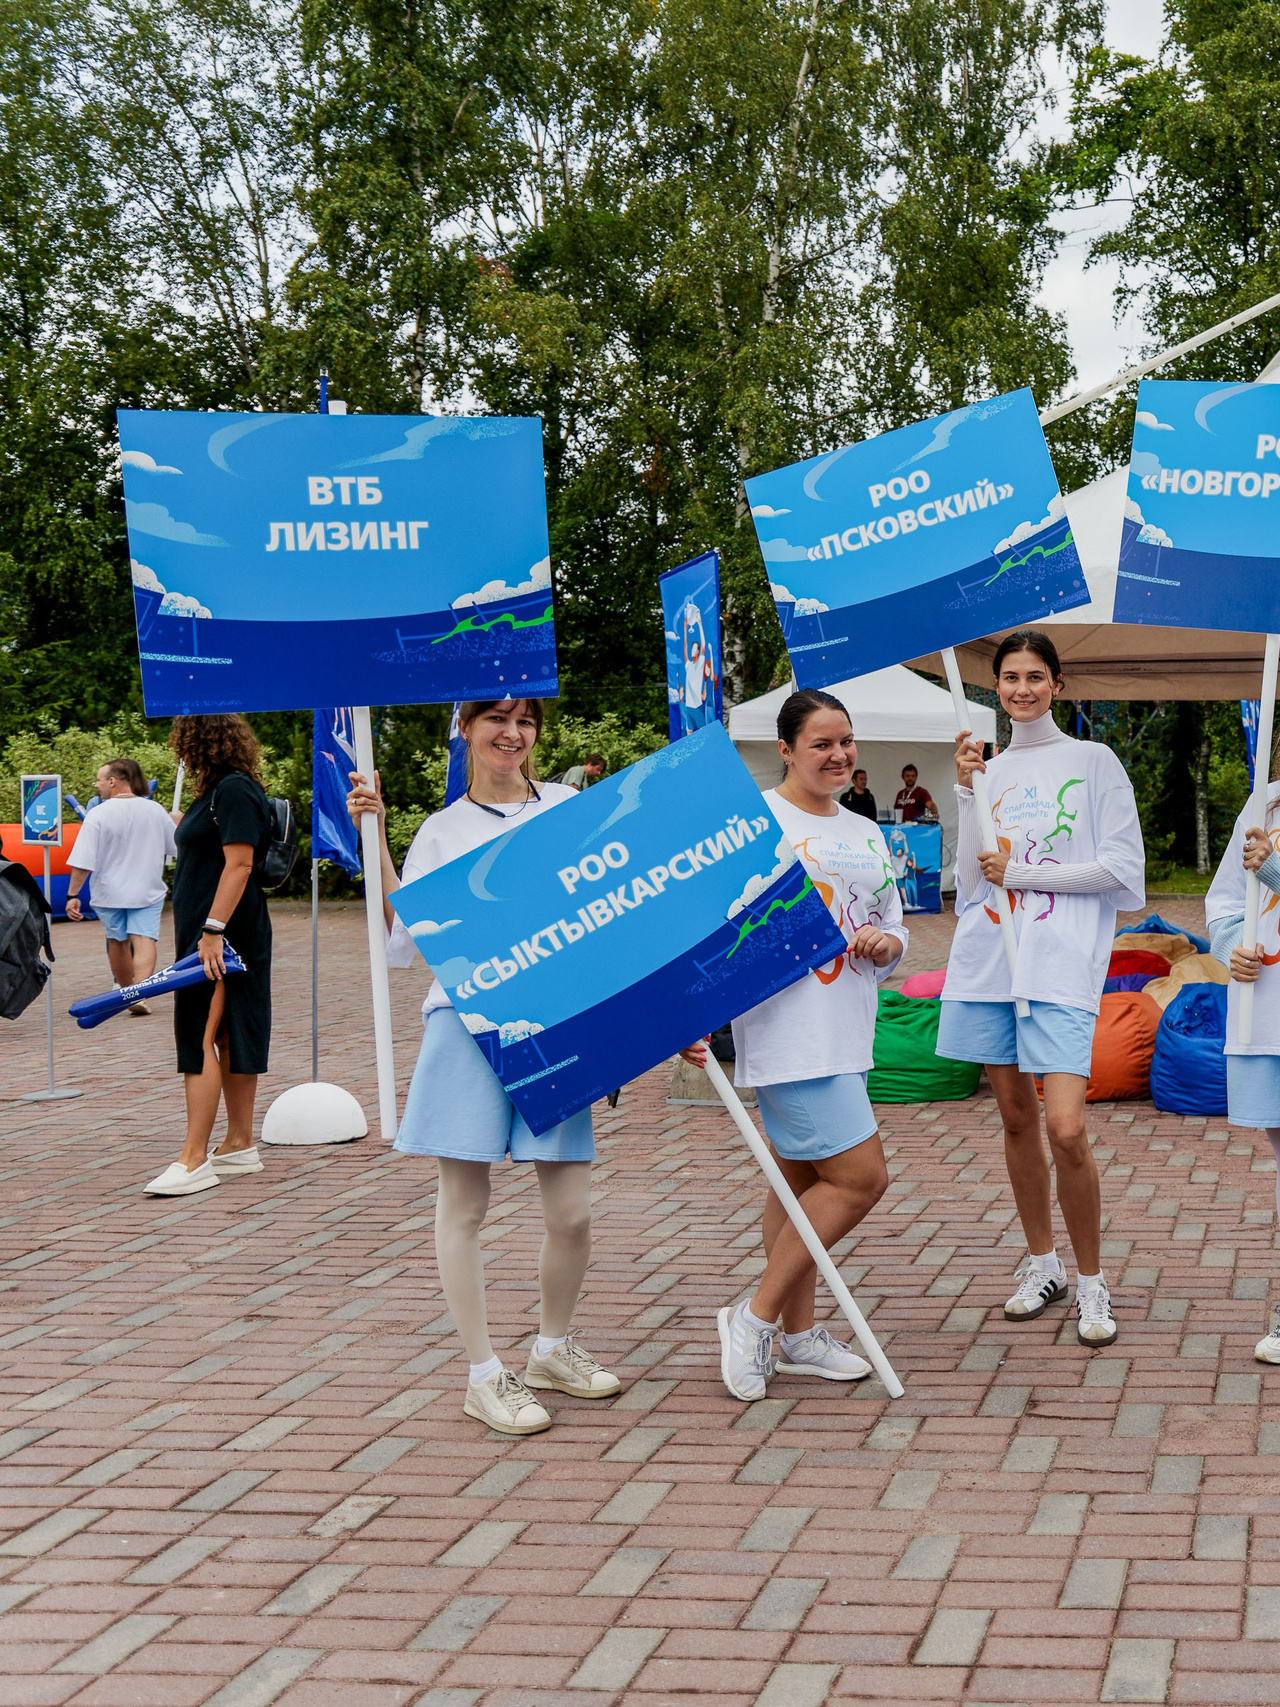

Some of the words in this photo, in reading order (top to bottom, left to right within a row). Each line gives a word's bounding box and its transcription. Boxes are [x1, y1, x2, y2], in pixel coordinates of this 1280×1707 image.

[308, 476, 383, 505] ВТБ
[868, 470, 931, 508] РОО
[806, 478, 1014, 562] «ПСКОВСКИЙ»
[265, 521, 429, 552] ЛИЗИНГ
[557, 841, 630, 895] РОО
[820, 849, 879, 860] СПАРТАКИАДА
[828, 861, 860, 870] ГРУППЫ
[861, 862, 876, 870] ВТБ
[456, 814, 769, 1000] «СЫКТЫВКАРСКИЙ»
[121, 990, 140, 1001] 2024
